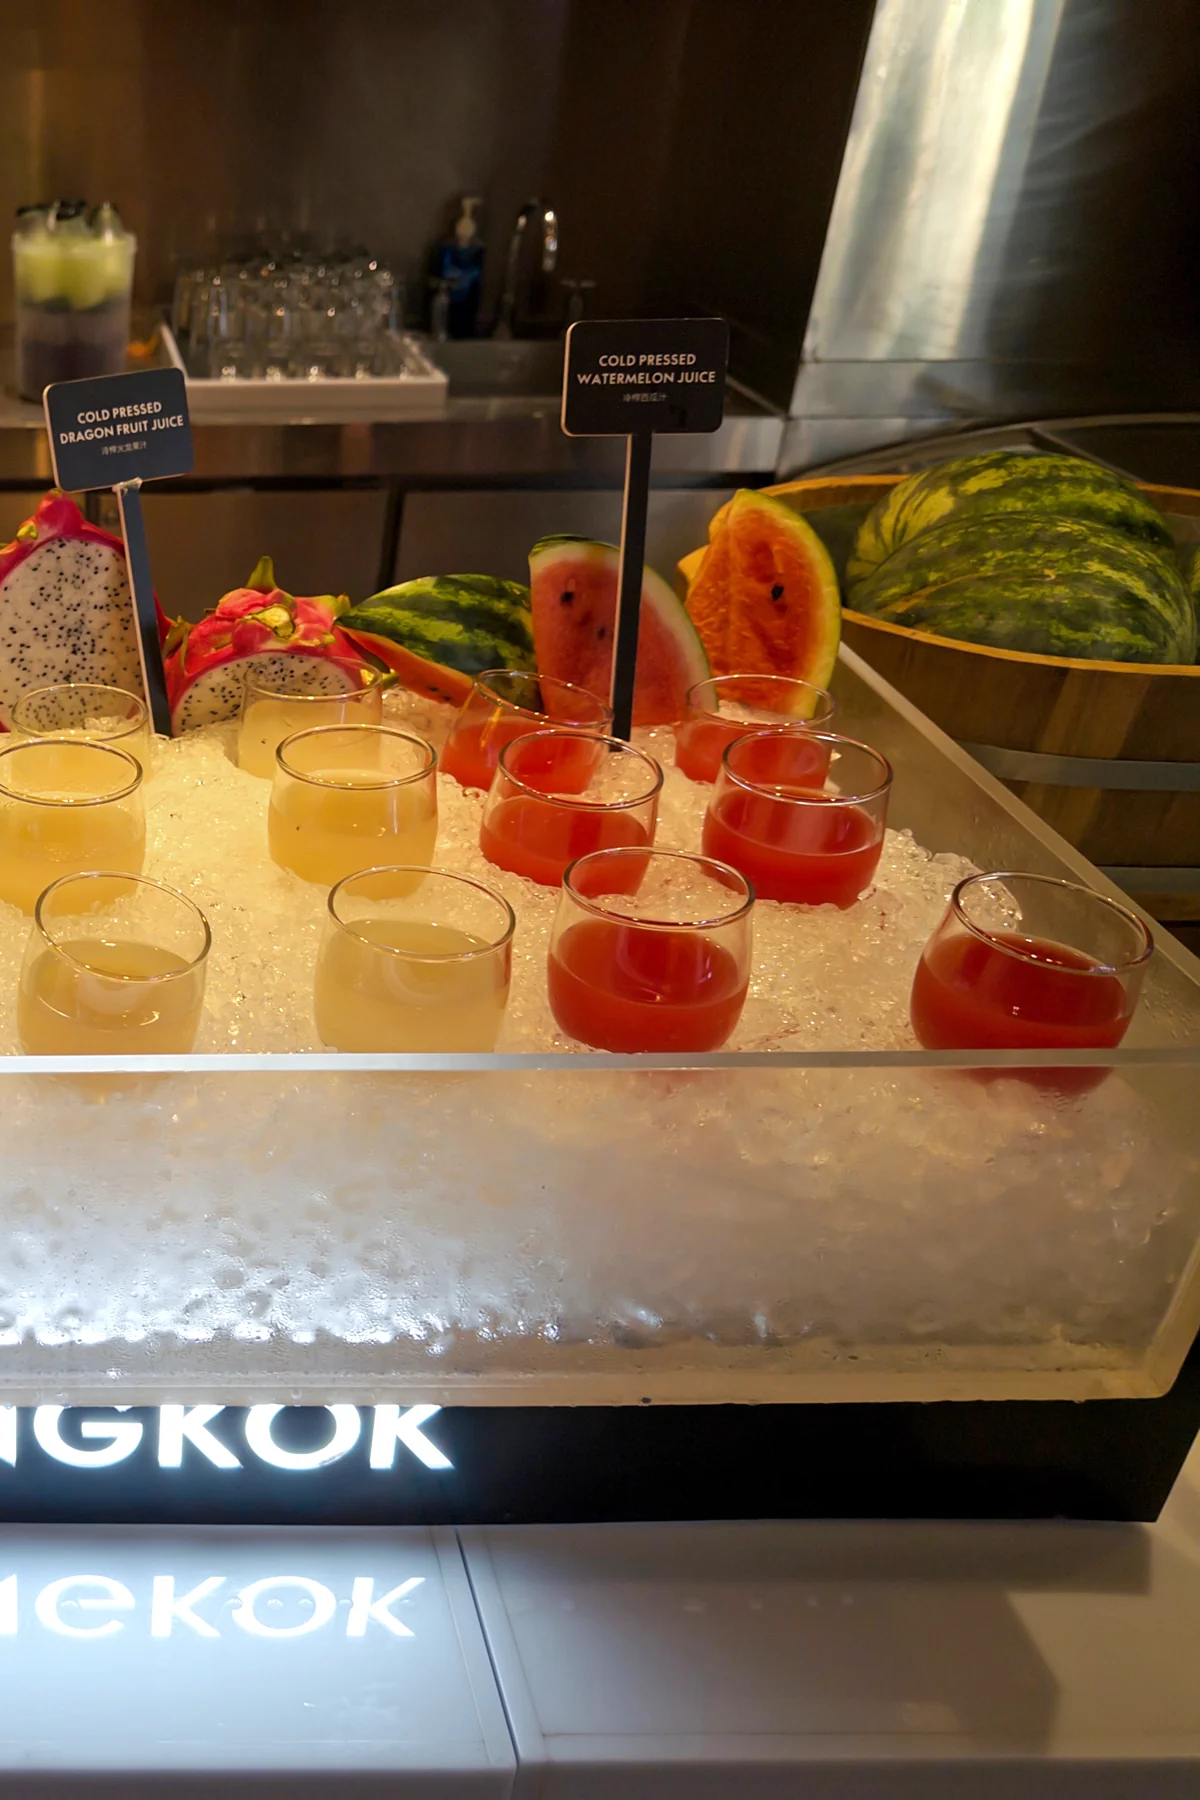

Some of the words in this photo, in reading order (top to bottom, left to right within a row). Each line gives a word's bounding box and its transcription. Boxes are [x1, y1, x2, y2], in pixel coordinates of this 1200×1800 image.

[598, 354, 637, 367] COLD
[638, 353, 697, 366] PRESSED
[576, 371, 675, 385] WATERMELON
[676, 370, 717, 384] JUICE
[77, 409, 111, 425] COLD
[112, 401, 163, 420] PRESSED
[59, 425, 115, 445] DRAGON
[116, 419, 149, 436] FRUIT
[151, 413, 185, 429] JUICE
